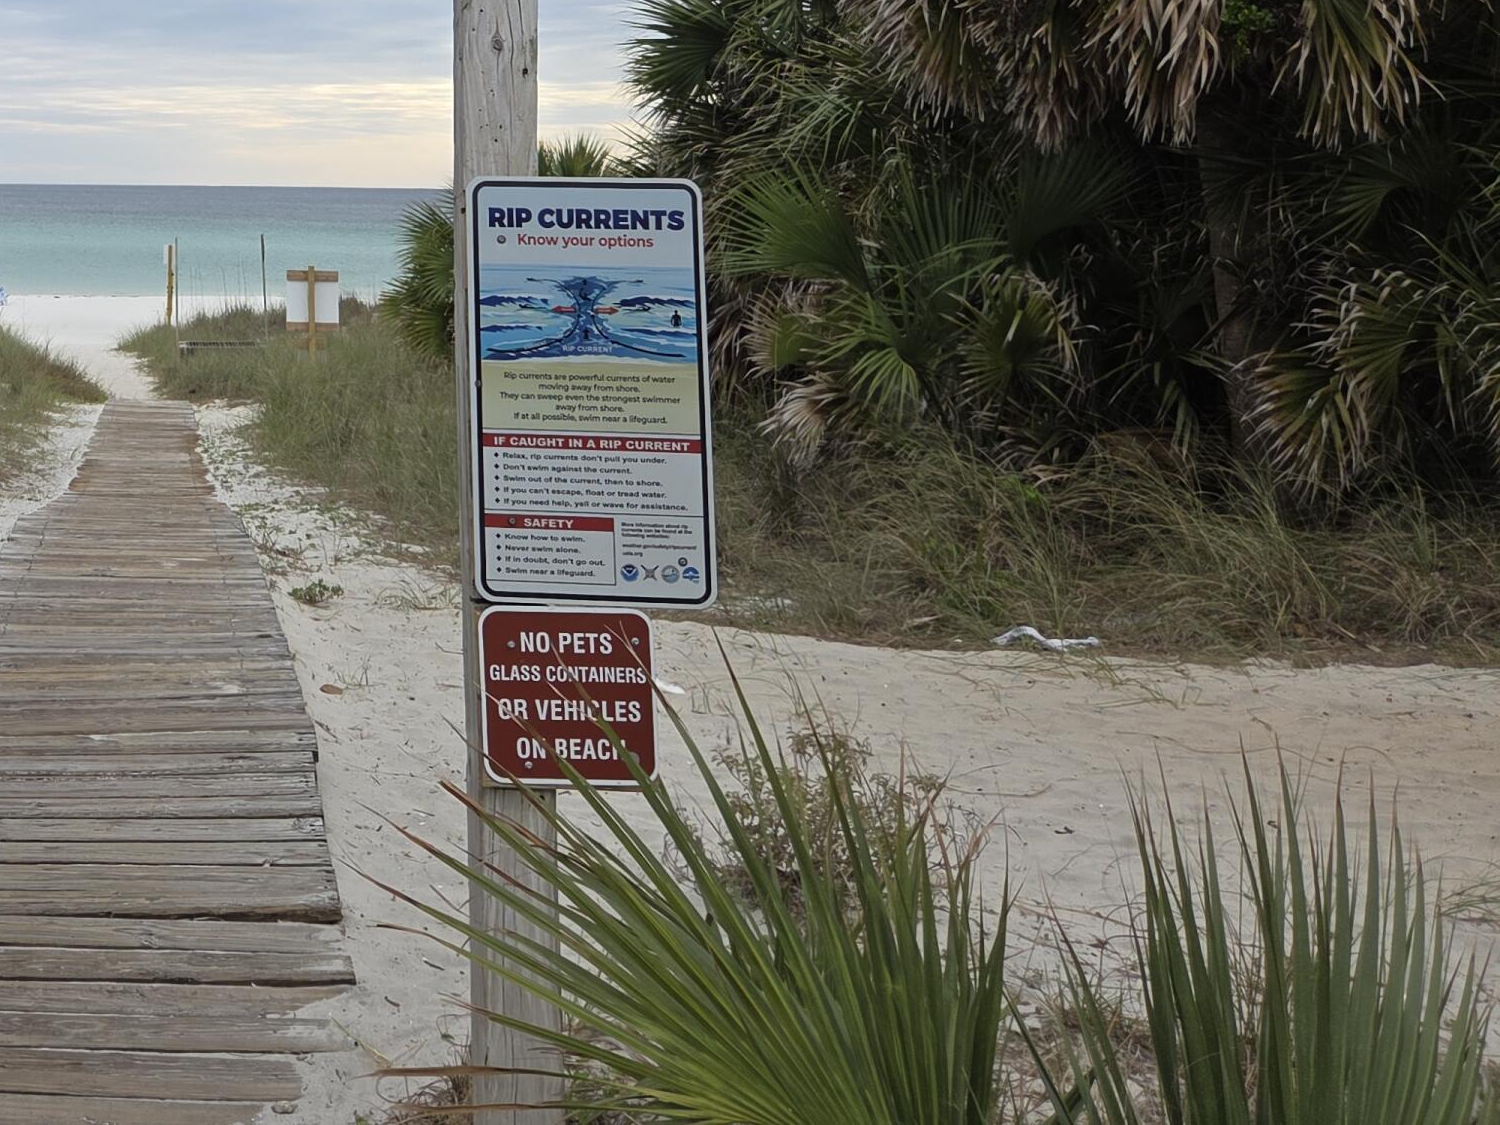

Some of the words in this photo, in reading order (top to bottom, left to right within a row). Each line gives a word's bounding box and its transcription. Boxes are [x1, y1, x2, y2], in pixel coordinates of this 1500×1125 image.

[488, 207, 532, 227] RIP
[537, 208, 684, 230] CURRENTS
[517, 233, 558, 245] Know
[561, 236, 595, 248] your
[598, 234, 653, 249] options
[494, 437, 506, 445] IF
[509, 437, 564, 447] CAUGHT
[568, 439, 582, 448] IN
[586, 439, 596, 448] A
[600, 440, 621, 449] RIP
[625, 441, 690, 451] CURRENT
[523, 519, 573, 528] SAFETY
[557, 569, 595, 577] lifeguard.
[520, 631, 549, 652] NO
[559, 632, 611, 653] PETS
[490, 664, 540, 681] GLASS
[546, 665, 646, 683] CONTAINERS
[498, 698, 528, 720] OR
[535, 699, 640, 721] VEHICLES
[516, 737, 545, 758] ON
